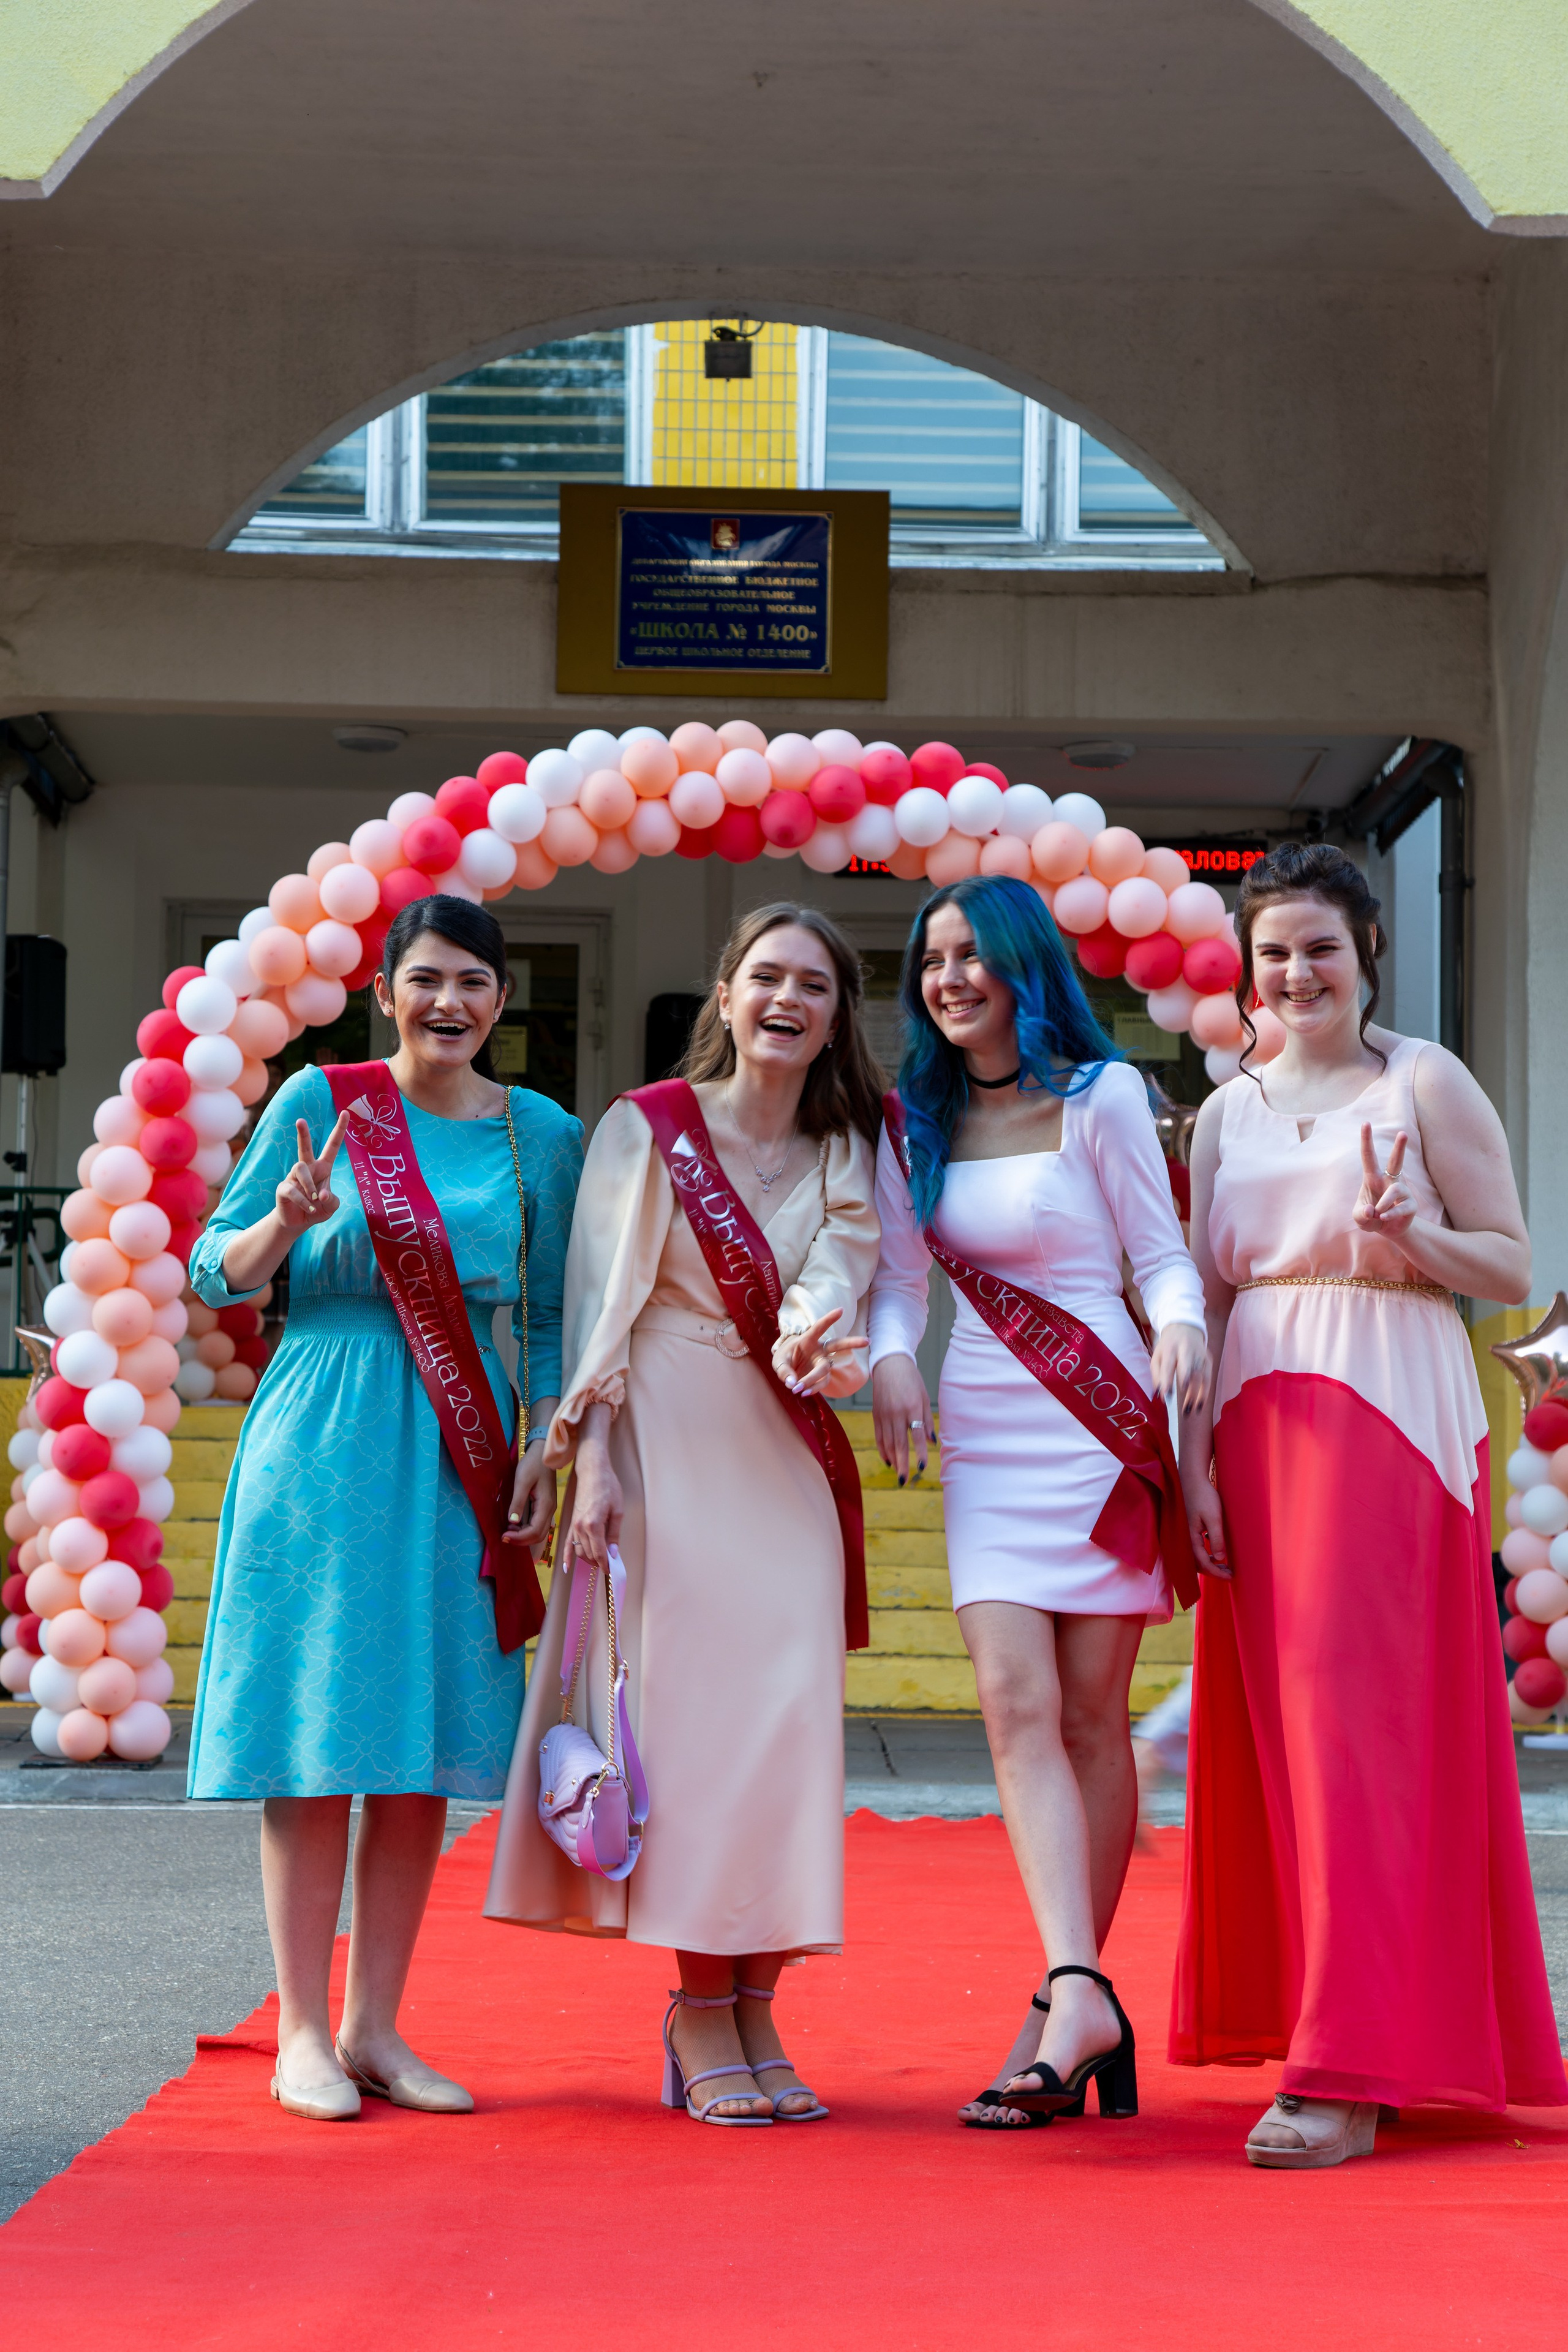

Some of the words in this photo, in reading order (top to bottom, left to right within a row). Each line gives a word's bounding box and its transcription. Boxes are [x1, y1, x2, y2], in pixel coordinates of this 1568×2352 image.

[630, 574, 739, 585] ГОСУДАРСТВЕННОЕ
[745, 576, 819, 586] БЮДЖЕТНОЕ
[653, 589, 796, 600] ОБЩЕОБРАЗОВАТЕЛЬНОЕ
[632, 601, 710, 611] УЧРЕЖДЕНИЕ
[715, 603, 760, 613] ГОРОДА
[766, 604, 816, 615] МОСКВЫ
[630, 622, 720, 639] «ШКОЛА
[726, 624, 747, 640] №
[757, 624, 818, 642] 1400»
[635, 646, 677, 656] ПЕРВОЕ
[681, 647, 744, 657] ШКОЛЬНОЕ
[747, 648, 812, 659] ОТДЕЛЕНИЕ
[353, 1161, 365, 1170] 11
[358, 1170, 371, 1185] "Л"
[361, 1189, 375, 1215] класс
[423, 1217, 450, 1289] Меликова
[760, 1261, 780, 1311] Лаптин
[367, 1152, 459, 1388] Выпускница
[447, 1384, 493, 1468] 2022
[385, 1271, 401, 1300] ГБОУ
[396, 1302, 413, 1335] Школа
[410, 1336, 430, 1373] №1400
[976, 1303, 1000, 1327] ГБОУ
[998, 1325, 1021, 1353] Школа
[1020, 1349, 1048, 1379] №1400
[1074, 1363, 1148, 1440] 2022
